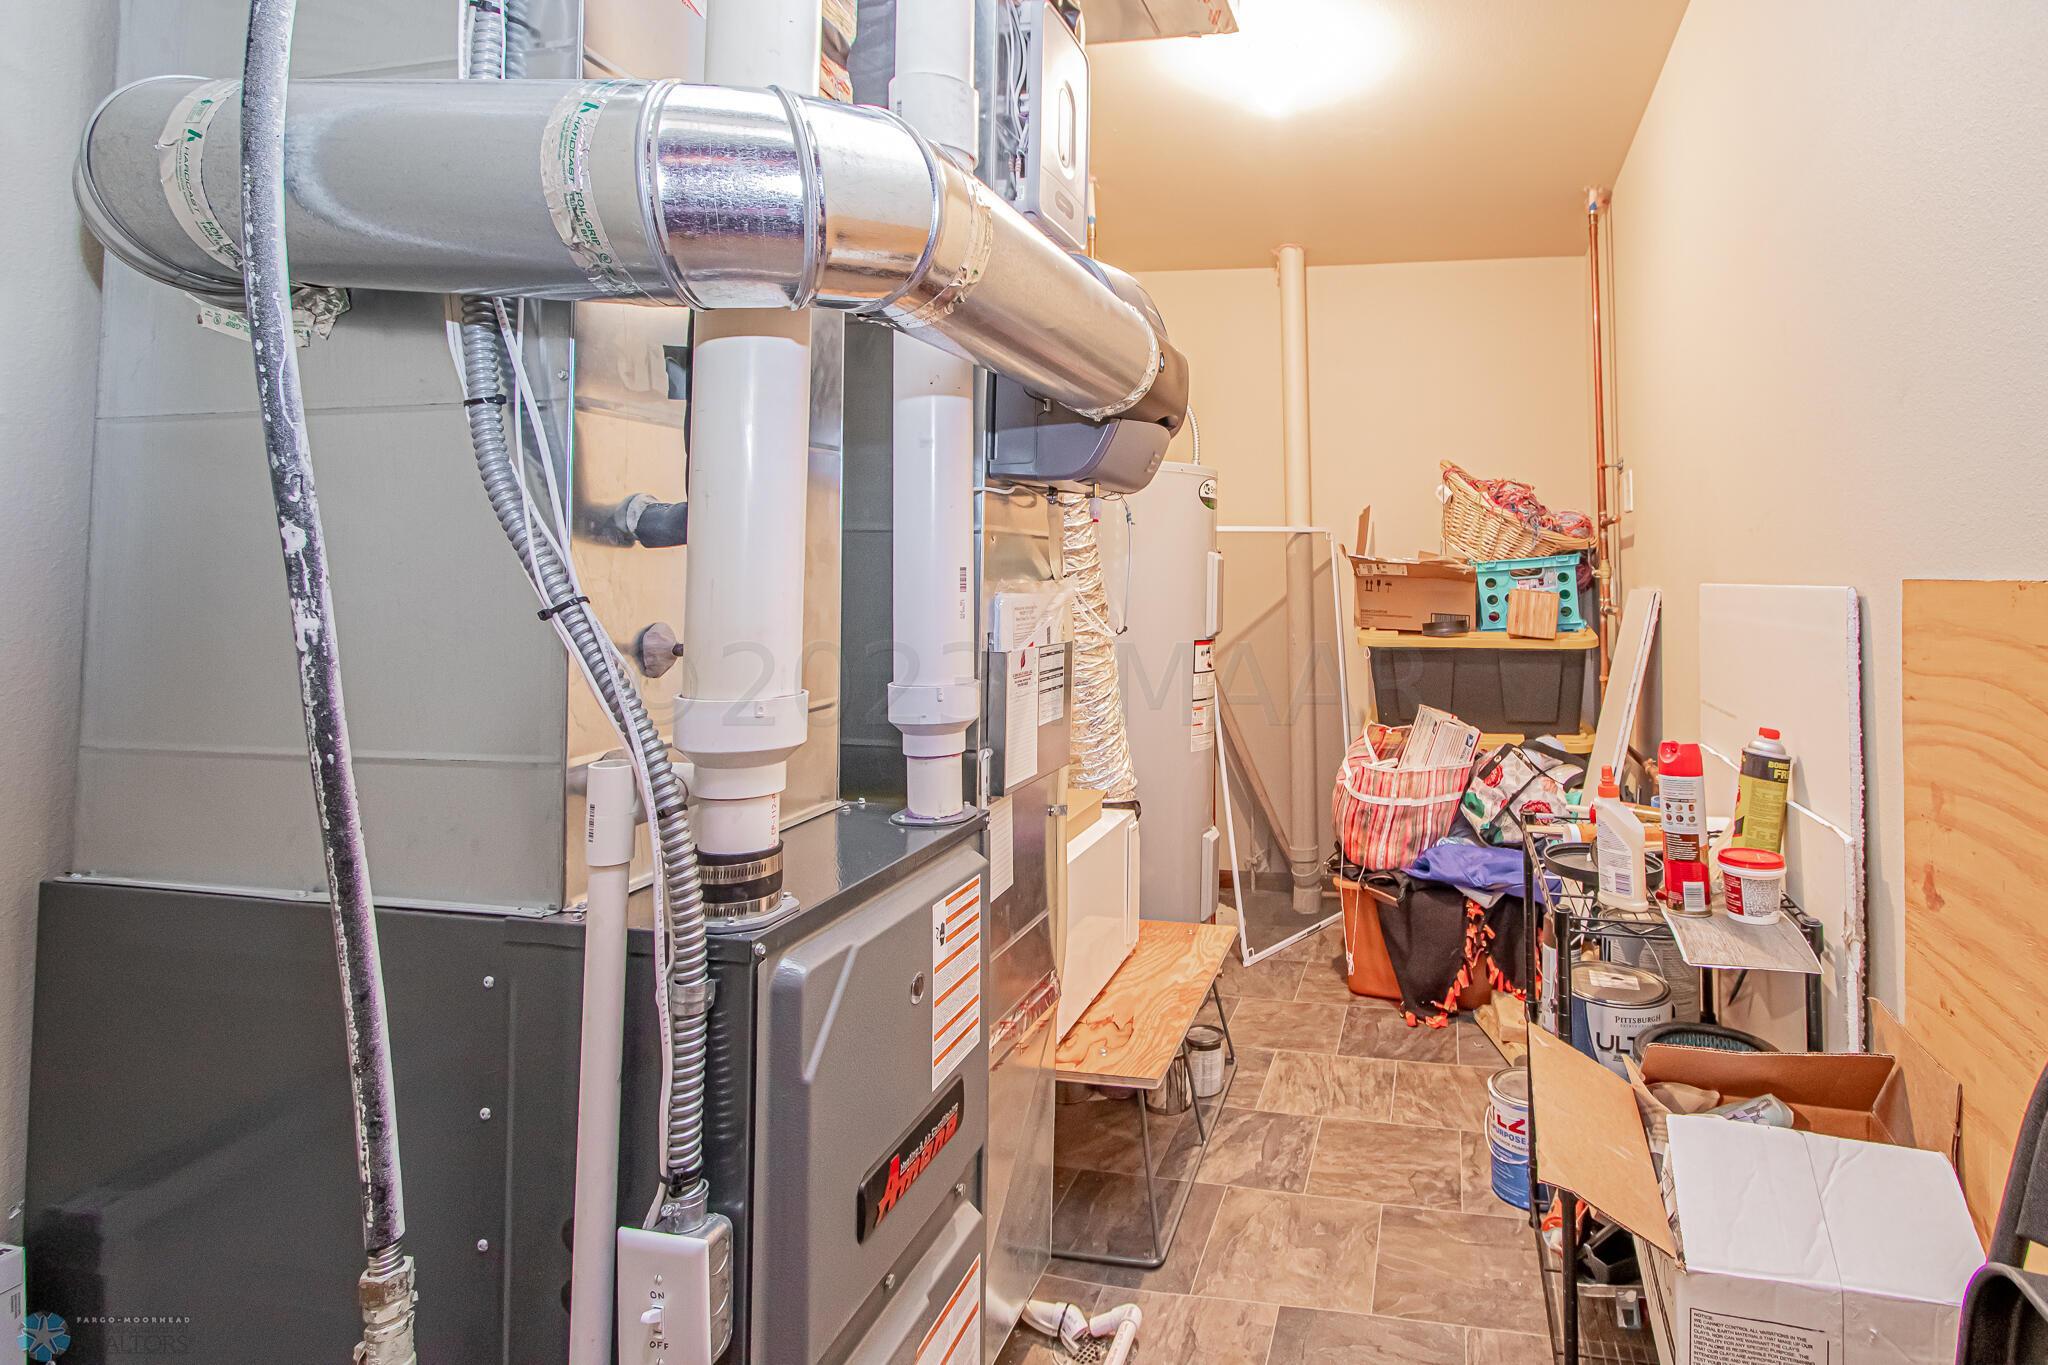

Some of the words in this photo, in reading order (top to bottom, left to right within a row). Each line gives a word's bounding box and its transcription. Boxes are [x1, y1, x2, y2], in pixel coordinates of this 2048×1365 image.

[567, 117, 583, 184] HARDCAST
[183, 146, 200, 213] HARDCAST
[1615, 1014, 1661, 1024] PITTSBURGH
[875, 1111, 959, 1227] Amana
[650, 1291, 665, 1299] ON
[1703, 1320, 1724, 1328] CANNOT
[1694, 1324, 1716, 1332] NATURAL
[1735, 1331, 1762, 1339] MATERIALS
[649, 1341, 669, 1350] OFF
[1732, 1347, 1766, 1357] RESPONSIBLE
